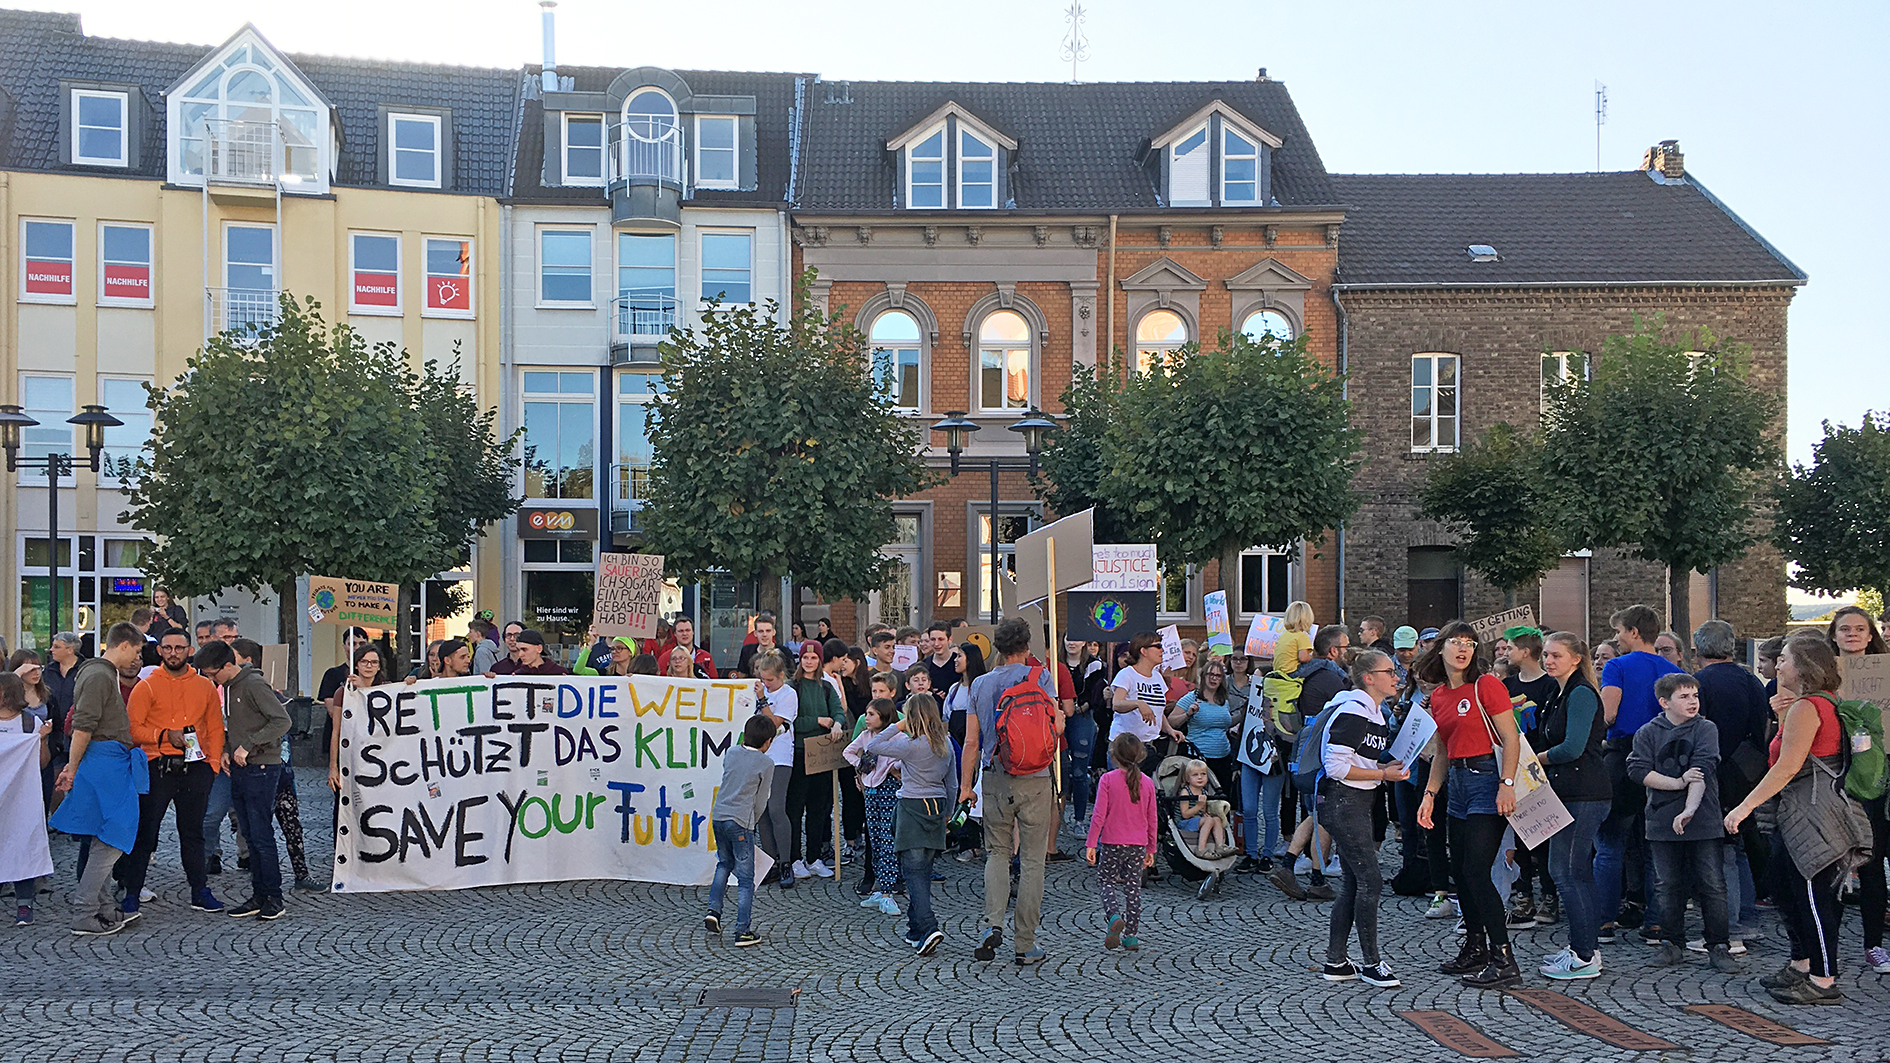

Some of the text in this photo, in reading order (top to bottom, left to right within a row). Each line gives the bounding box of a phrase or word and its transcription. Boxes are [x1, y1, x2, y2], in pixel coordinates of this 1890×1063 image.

[28, 273, 70, 283] NACHHILFE
[106, 277, 148, 287] NACHHILFE
[356, 285, 396, 295] NACHHILFE
[532, 515, 572, 526] evm
[1113, 547, 1129, 558] too
[1130, 545, 1155, 558] much
[604, 554, 659, 566] ICH BIN SO
[604, 564, 662, 580] SAUER DASS
[345, 582, 389, 594] YOU ARE
[600, 575, 656, 591] ICH SOGAR
[1101, 579, 1117, 589] on
[1119, 573, 1127, 589] 1
[1128, 575, 1154, 592] sign
[597, 589, 660, 602] EIN PLAKAT
[358, 601, 380, 609] MAKE
[382, 603, 391, 611] A
[596, 601, 659, 615] GEBASTELT
[338, 611, 397, 625] DIFFERENCE
[1487, 606, 1530, 626] GETTING
[1255, 617, 1286, 633] STO
[1848, 656, 1881, 670] NOCH
[1852, 676, 1885, 694] NICHT
[367, 682, 748, 737] RETTET DIE WELT
[554, 724, 622, 766] DAS
[635, 723, 744, 769] KLIM
[358, 795, 489, 868] SAVE
[607, 780, 719, 852] Futur
